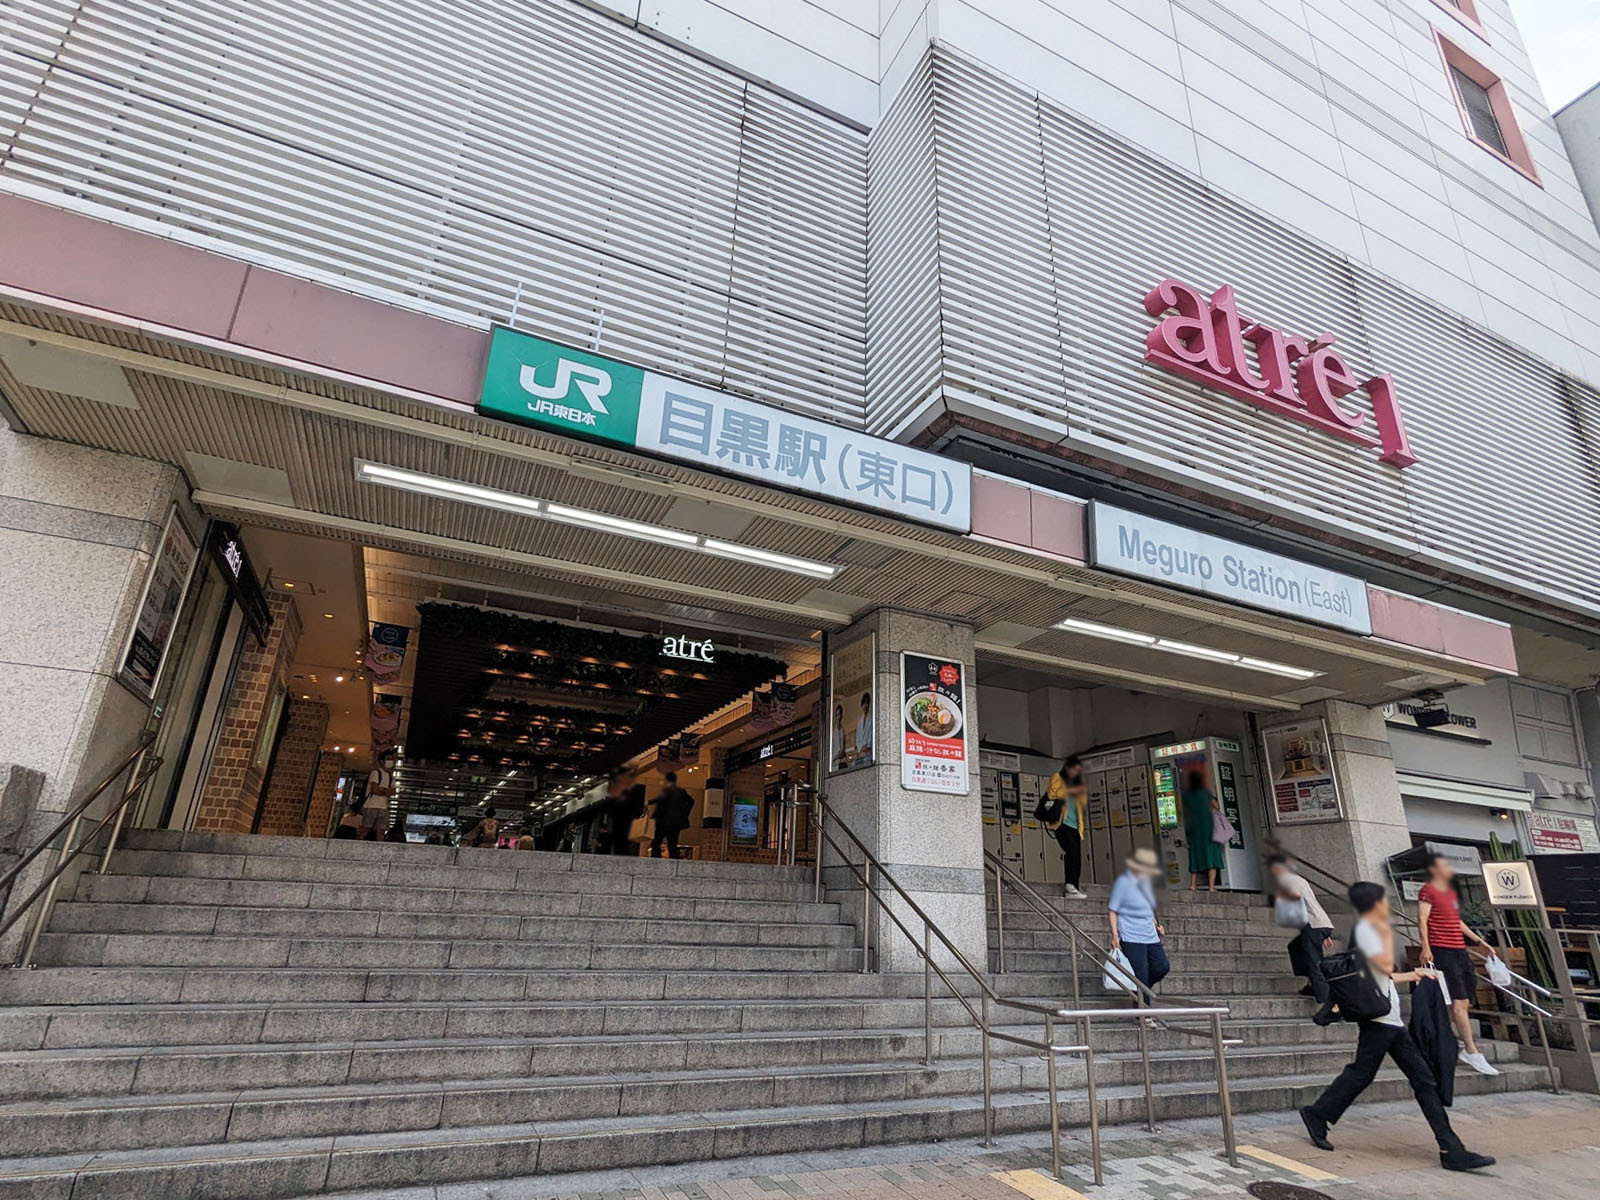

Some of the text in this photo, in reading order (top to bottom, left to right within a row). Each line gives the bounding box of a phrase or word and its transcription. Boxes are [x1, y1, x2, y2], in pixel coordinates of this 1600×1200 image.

[519, 358, 612, 415] JR
[527, 399, 597, 427] JR東日本
[1119, 524, 1352, 618] Meguro Station (East)
[662, 634, 715, 661] atré
